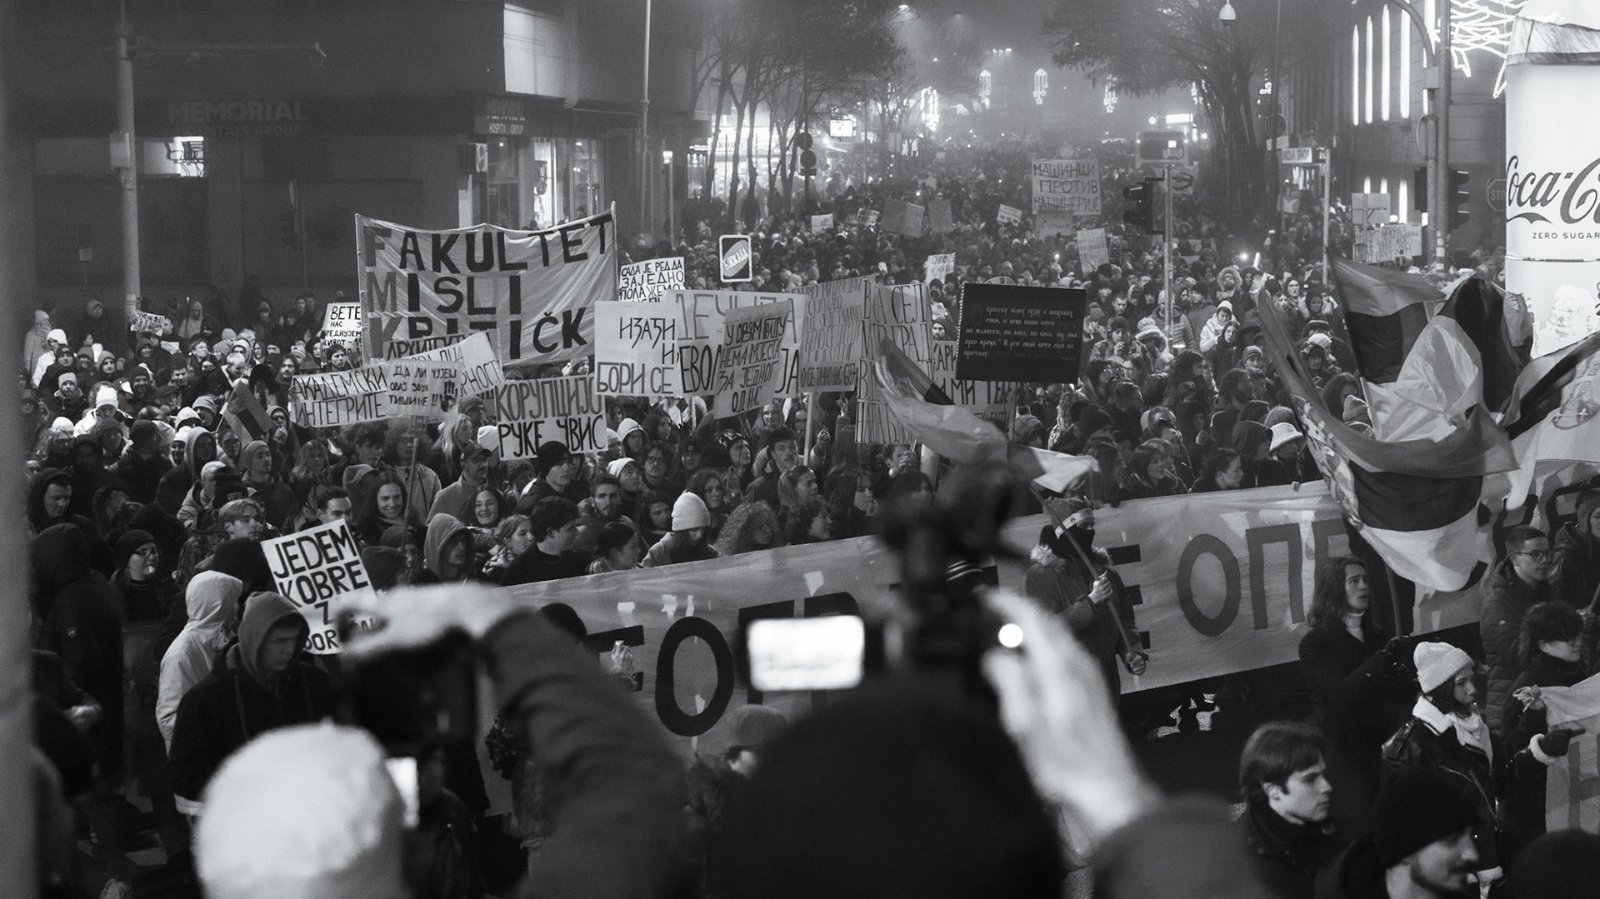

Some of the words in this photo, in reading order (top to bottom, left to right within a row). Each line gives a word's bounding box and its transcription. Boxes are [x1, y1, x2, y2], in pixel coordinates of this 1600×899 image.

[168, 101, 308, 121] MEMORIAL
[254, 125, 302, 137] GROUP
[1040, 179, 1098, 193] ПРОТИВ
[1506, 155, 1600, 224] Coca-C
[364, 214, 612, 273] FAKULTET
[622, 265, 641, 277] САДА
[643, 263, 652, 273] ЈЕ
[671, 259, 683, 270] ДА
[622, 270, 684, 289] ЗАЈЕДНО
[366, 272, 521, 315] MISLI
[331, 306, 361, 320] ВЕТЕ
[620, 317, 675, 348] ИЗАЂИ
[725, 324, 735, 346] У
[662, 343, 675, 364] И
[719, 345, 748, 368] НЕМА
[292, 366, 388, 401] АКАДЕМСКИ
[393, 366, 411, 378] ДА
[414, 367, 427, 378] ЛИ
[597, 362, 645, 394] БОРИ
[650, 367, 675, 394] СЕ
[716, 369, 735, 395] ЗА
[389, 381, 408, 391] ОВАЈ
[295, 390, 387, 426] ИНТЕГРИТЕ
[389, 394, 428, 406] ТИШИНЕ
[731, 390, 746, 413] ОД
[498, 420, 545, 457] РУКЕ
[273, 524, 357, 579] JEDEM
[279, 560, 369, 608] KOBRE
